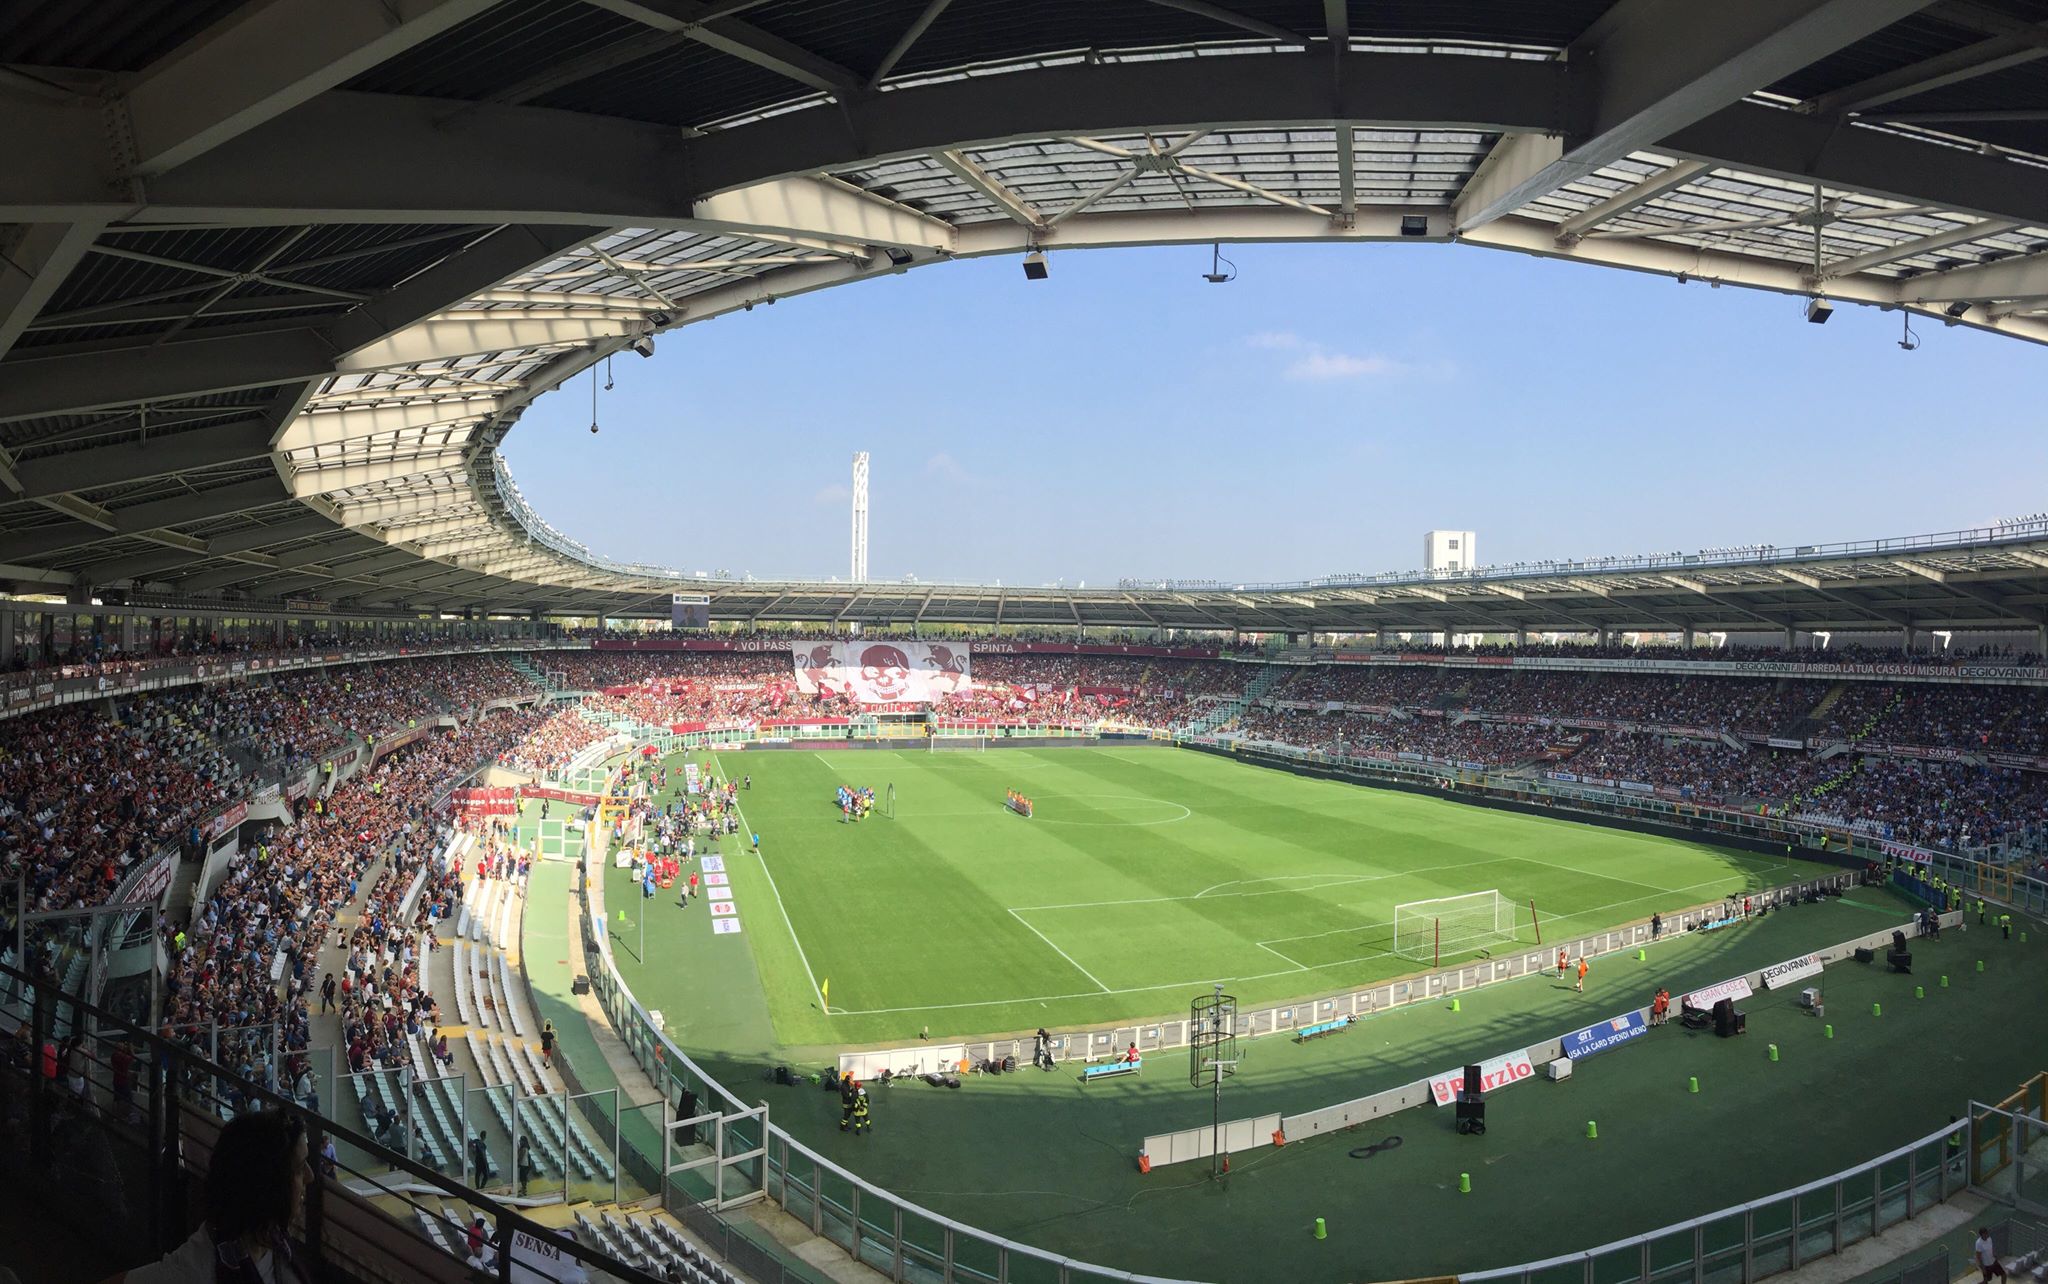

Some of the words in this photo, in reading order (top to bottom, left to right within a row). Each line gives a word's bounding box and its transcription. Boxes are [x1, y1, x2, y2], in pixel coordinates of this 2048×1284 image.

[741, 641, 760, 651] VOI
[1735, 662, 1791, 671] DEGIOVANNI
[1806, 663, 1841, 673] ARREDA
[1843, 664, 1855, 673] LA
[1856, 664, 1874, 673] TUA
[1876, 665, 1901, 674] CASA
[1902, 665, 1916, 675] SU
[1917, 665, 1956, 676] MISURA
[1960, 667, 2035, 678] DEGIOVANNI
[461, 798, 485, 806] Kappa
[1882, 842, 1932, 863] inalpi
[1762, 957, 1810, 980] DEGIOVANNI
[1700, 987, 1721, 1001] GRAN
[1721, 981, 1738, 994] CASE
[1578, 1029, 1592, 1041] GTT
[1568, 1048, 1582, 1059] USA
[1581, 1045, 1591, 1054] LA
[1591, 1039, 1608, 1051] CARD
[1608, 1031, 1629, 1045] SPENDI
[1629, 1025, 1647, 1037] MENO
[516, 1233, 560, 1261] SENSA
